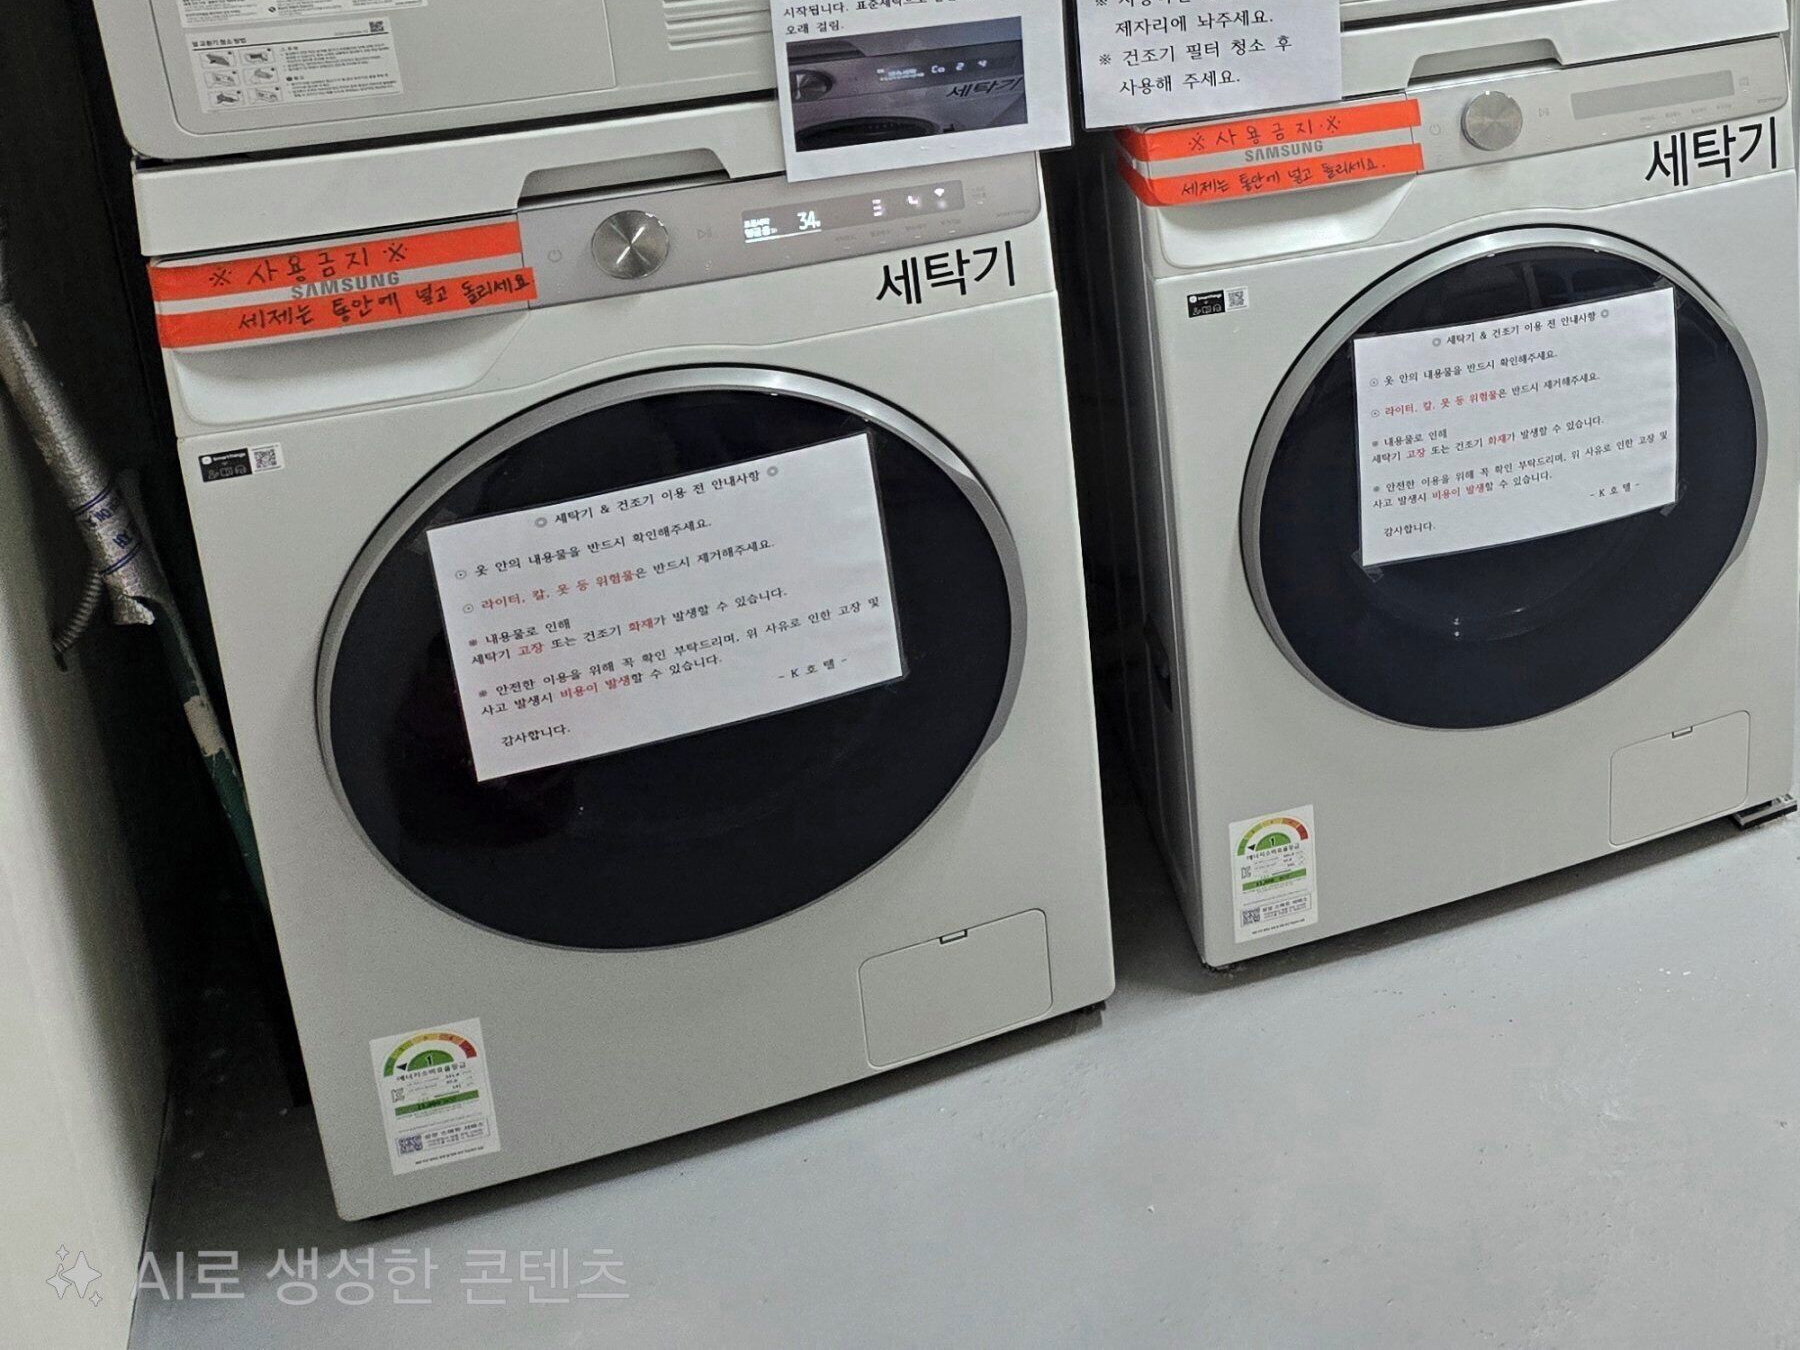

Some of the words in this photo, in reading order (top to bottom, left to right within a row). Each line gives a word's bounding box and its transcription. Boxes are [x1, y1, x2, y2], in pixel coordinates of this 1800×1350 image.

[783, 1, 848, 18] 시작됩니다.
[1115, 14, 1186, 37] 제자리에
[1197, 9, 1273, 29] 놔주세요.
[785, 22, 808, 35] 오래
[1122, 45, 1174, 66] 건조기
[1186, 40, 1219, 60] 필터
[1230, 38, 1265, 56] 청소
[1274, 34, 1292, 51] 후
[946, 75, 1024, 98] 세탁기
[1119, 74, 1171, 96] 사용해
[1182, 69, 1240, 89] 주세요.
[1244, 139, 1324, 163] SAMSUNG
[1644, 116, 1778, 187] 세탁기
[1181, 168, 1230, 197] 세제는
[1239, 162, 1281, 191] 통안에
[291, 271, 400, 300] SAMSUNG
[876, 240, 1017, 306] 세탁기
[239, 303, 315, 330] 세제는
[332, 291, 403, 324] 통안에
[1446, 331, 1474, 344] 세탁기
[1479, 330, 1486, 340] &
[1492, 324, 1519, 338] 건조기
[1524, 320, 1542, 332] 이용
[1547, 318, 1555, 329] 전
[1560, 310, 1595, 326] 안내사항
[554, 506, 593, 523] 세탁기
[600, 504, 610, 514] &
[617, 493, 654, 511] 건조기
[661, 486, 686, 500] 이용
[692, 482, 705, 494] 전
[711, 469, 759, 490] 안내사항
[474, 564, 488, 577] 옷
[494, 557, 521, 572] 안의
[527, 546, 580, 565] 내용물을
[586, 535, 625, 553] 반드시
[632, 518, 711, 543] 확인해주세요.
[556, 583, 569, 596] 못
[576, 578, 589, 591] 등
[595, 567, 647, 587] 위험물은
[652, 556, 690, 574] 반드시
[697, 539, 774, 563] 제거해주세요.
[471, 648, 510, 665] 세탁기
[518, 641, 544, 655] 고장
[551, 636, 576, 649] 또는
[583, 624, 621, 642] 건조기
[628, 614, 666, 632] 화재가
[671, 604, 708, 622] 발생할
[716, 601, 728, 612] 수
[734, 587, 787, 608] 있습니다.
[485, 626, 539, 644] 내용물로
[545, 618, 570, 633] 인해
[495, 678, 535, 696] 안전한
[542, 668, 581, 685] 이용을
[589, 660, 614, 676] 위해
[622, 657, 634, 667] 꼭
[641, 649, 666, 663] 확인
[746, 627, 758, 639] 위
[765, 617, 801, 633] 사유로
[807, 608, 830, 624] 인한
[838, 601, 861, 615] 고장
[867, 596, 879, 608] 및
[481, 702, 508, 715] 사고
[513, 691, 553, 709] 발생시
[559, 681, 598, 698] 비용이
[604, 671, 643, 689] 발생할
[650, 668, 662, 679] 수
[668, 654, 721, 675] 있습니다.
[501, 723, 570, 747] 감사합니다.
[426, 1055, 432, 1066] 1
